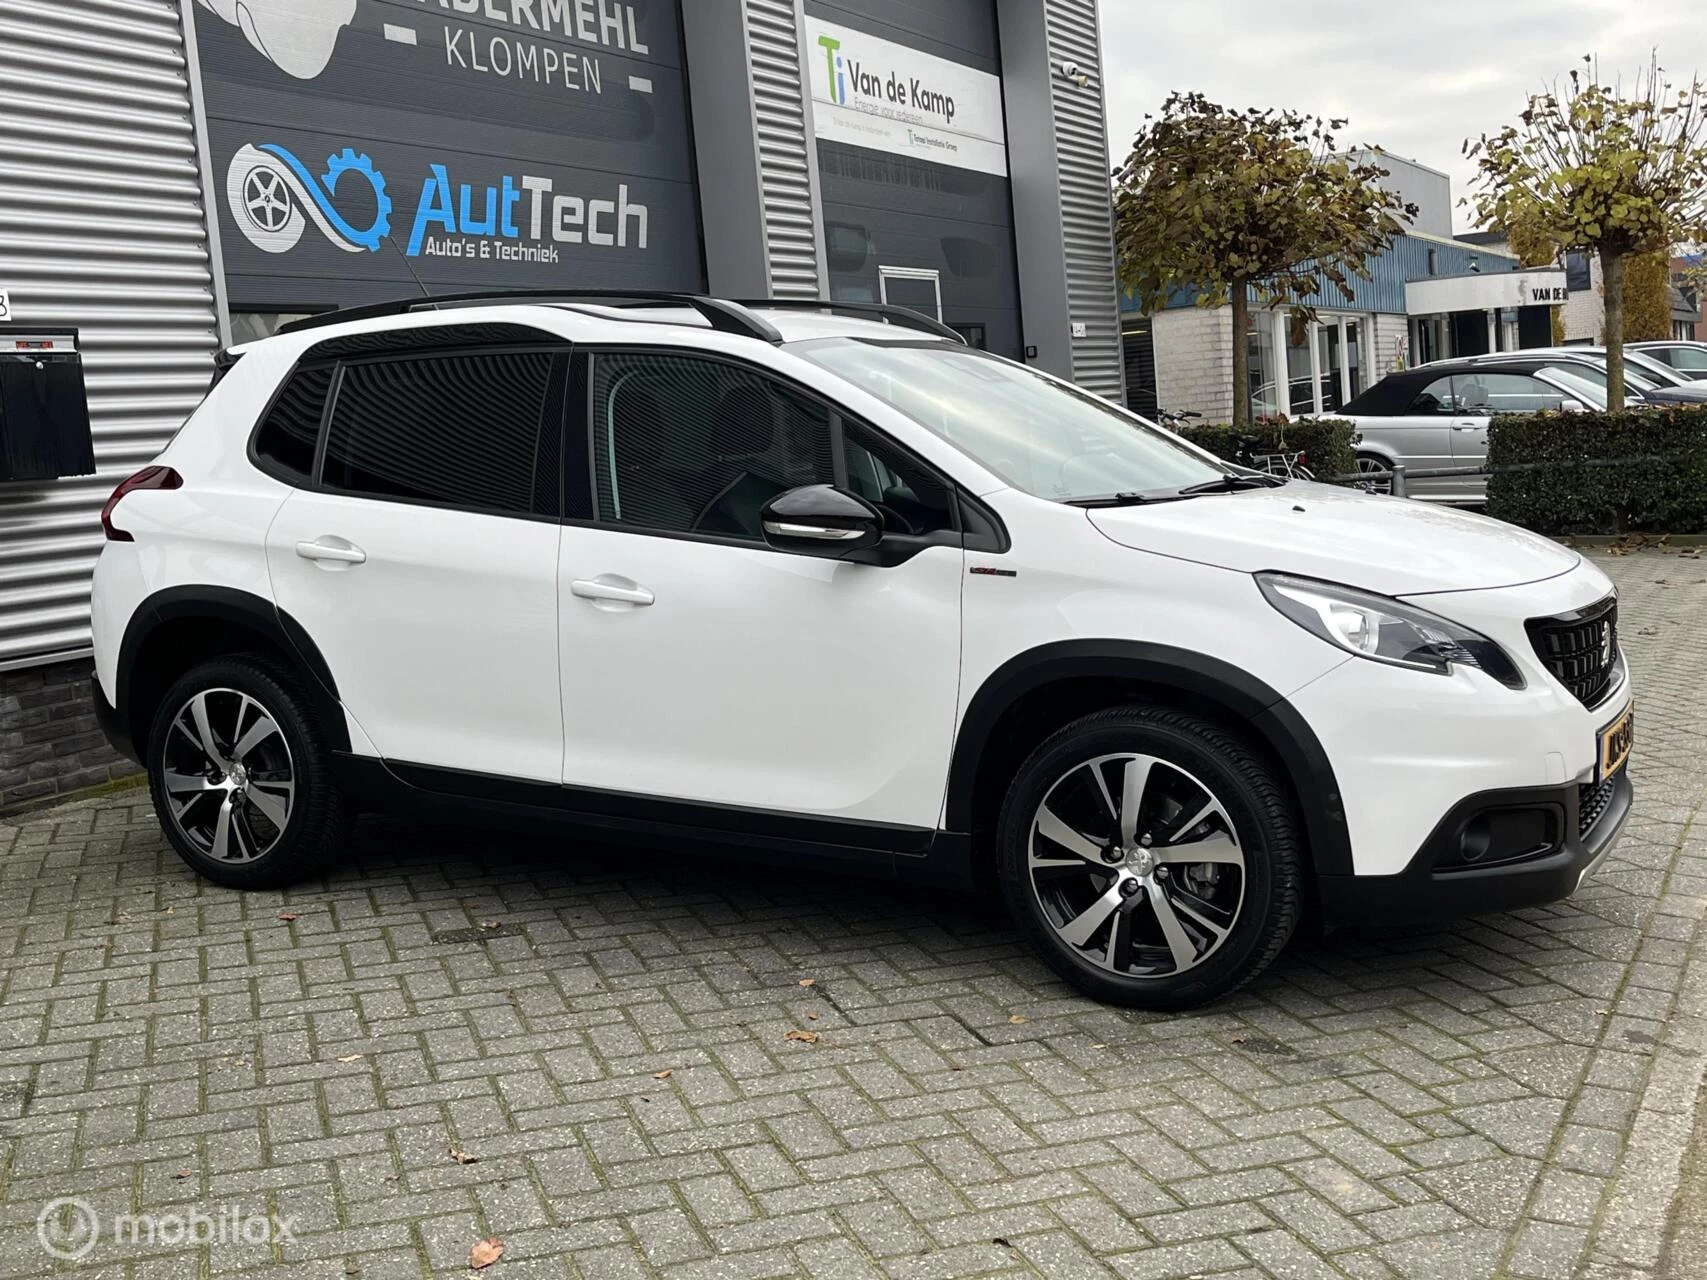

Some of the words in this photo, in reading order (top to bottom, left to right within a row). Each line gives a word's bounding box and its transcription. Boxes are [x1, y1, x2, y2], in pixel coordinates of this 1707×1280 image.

[415, 0, 649, 55] RMEHL
[444, 26, 602, 95] KLOMPEN
[847, 59, 882, 98] Van
[886, 71, 906, 105] de
[910, 77, 955, 124] Kamp
[406, 163, 648, 257] AutTech
[425, 236, 475, 258] Auto's
[479, 240, 491, 259] &
[494, 241, 559, 263] Techniek
[1532, 287, 1551, 301] VAN
